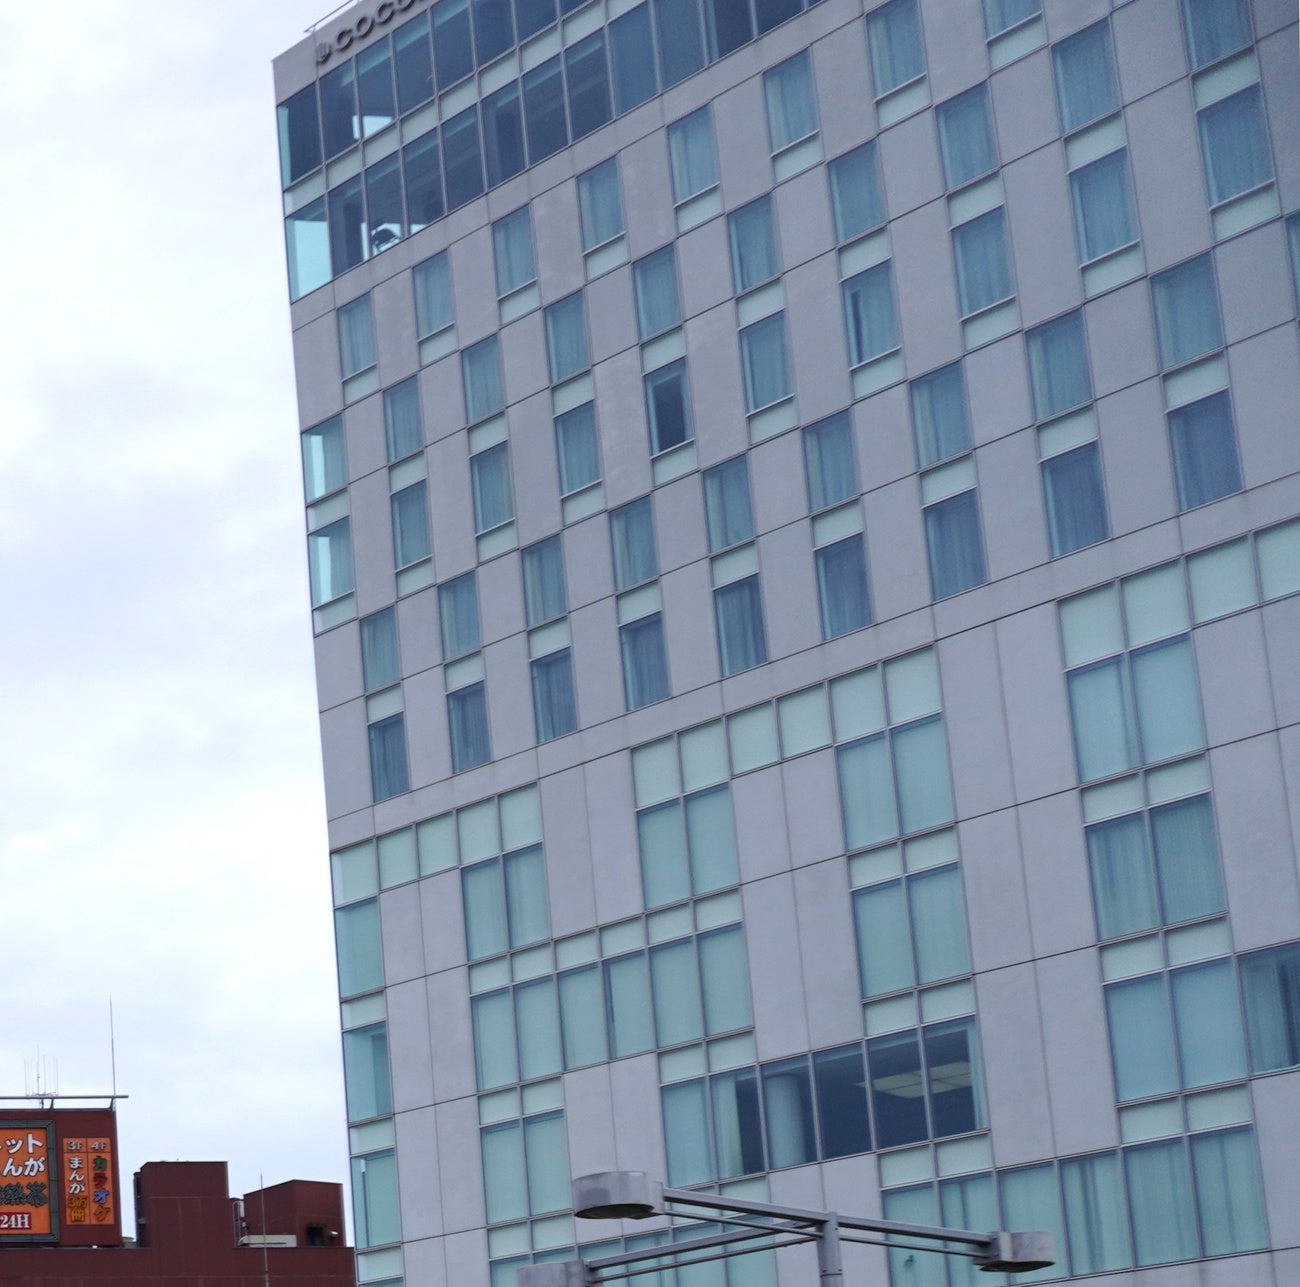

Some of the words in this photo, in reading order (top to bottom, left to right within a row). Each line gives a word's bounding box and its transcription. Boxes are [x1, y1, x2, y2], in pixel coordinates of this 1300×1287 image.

[68, 1141, 83, 1150] 3F
[91, 1141, 106, 1150] 4F
[69, 1156, 86, 1194] まんが
[92, 1156, 111, 1222] カラオケ
[0, 1214, 30, 1229] 24H
